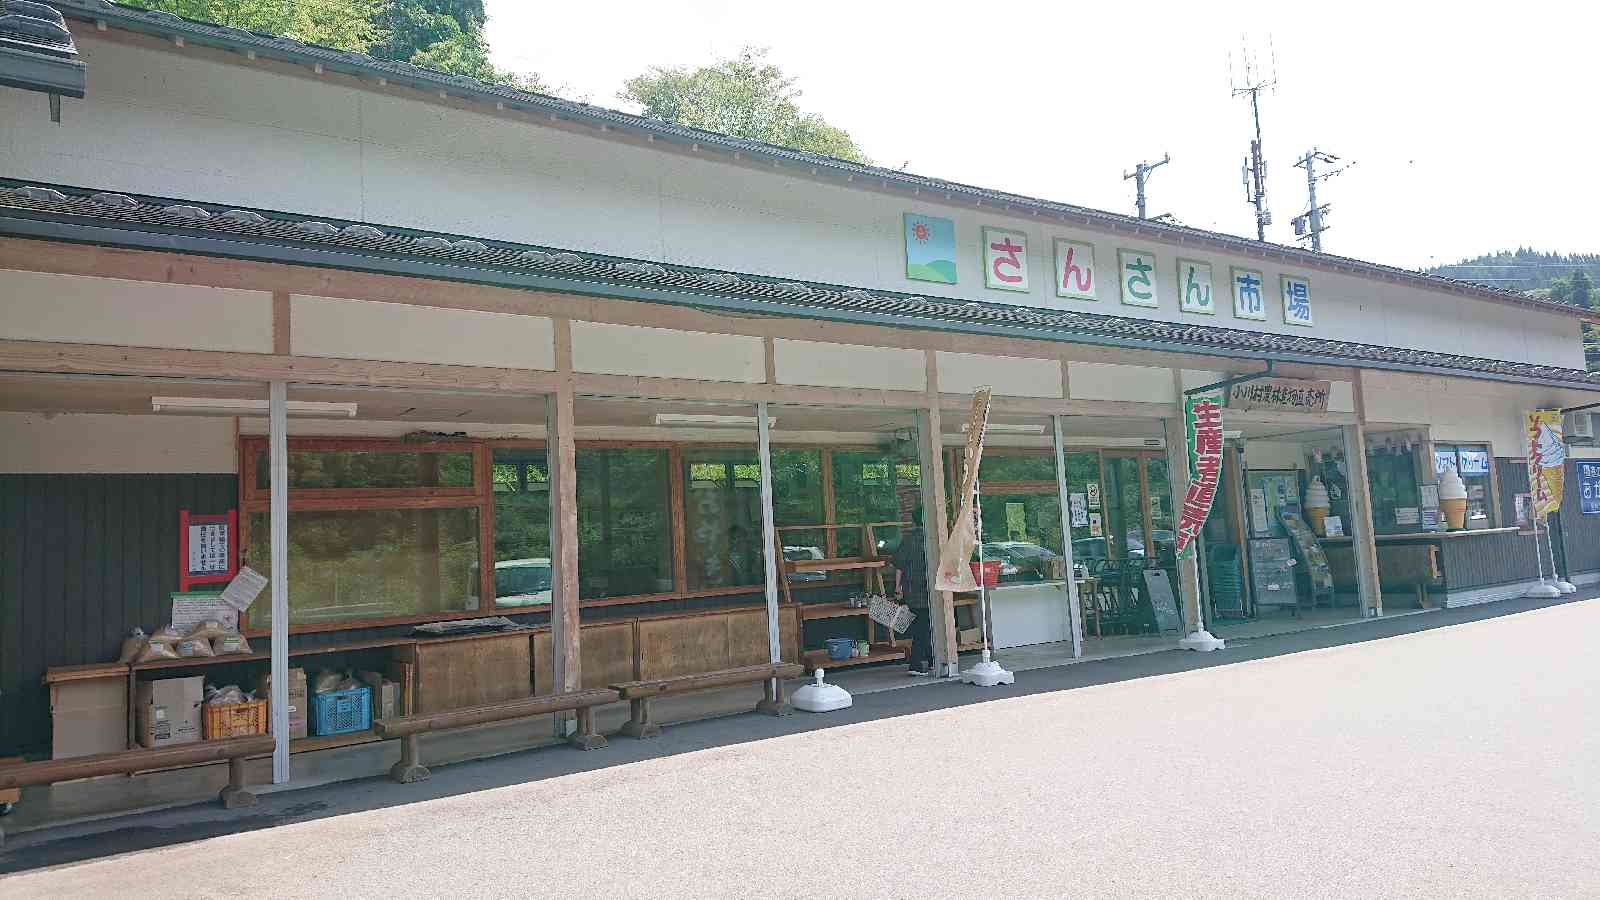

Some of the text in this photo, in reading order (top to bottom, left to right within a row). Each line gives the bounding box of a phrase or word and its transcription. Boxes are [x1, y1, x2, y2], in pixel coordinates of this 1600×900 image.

[990, 237, 1310, 321] さんさん市場
